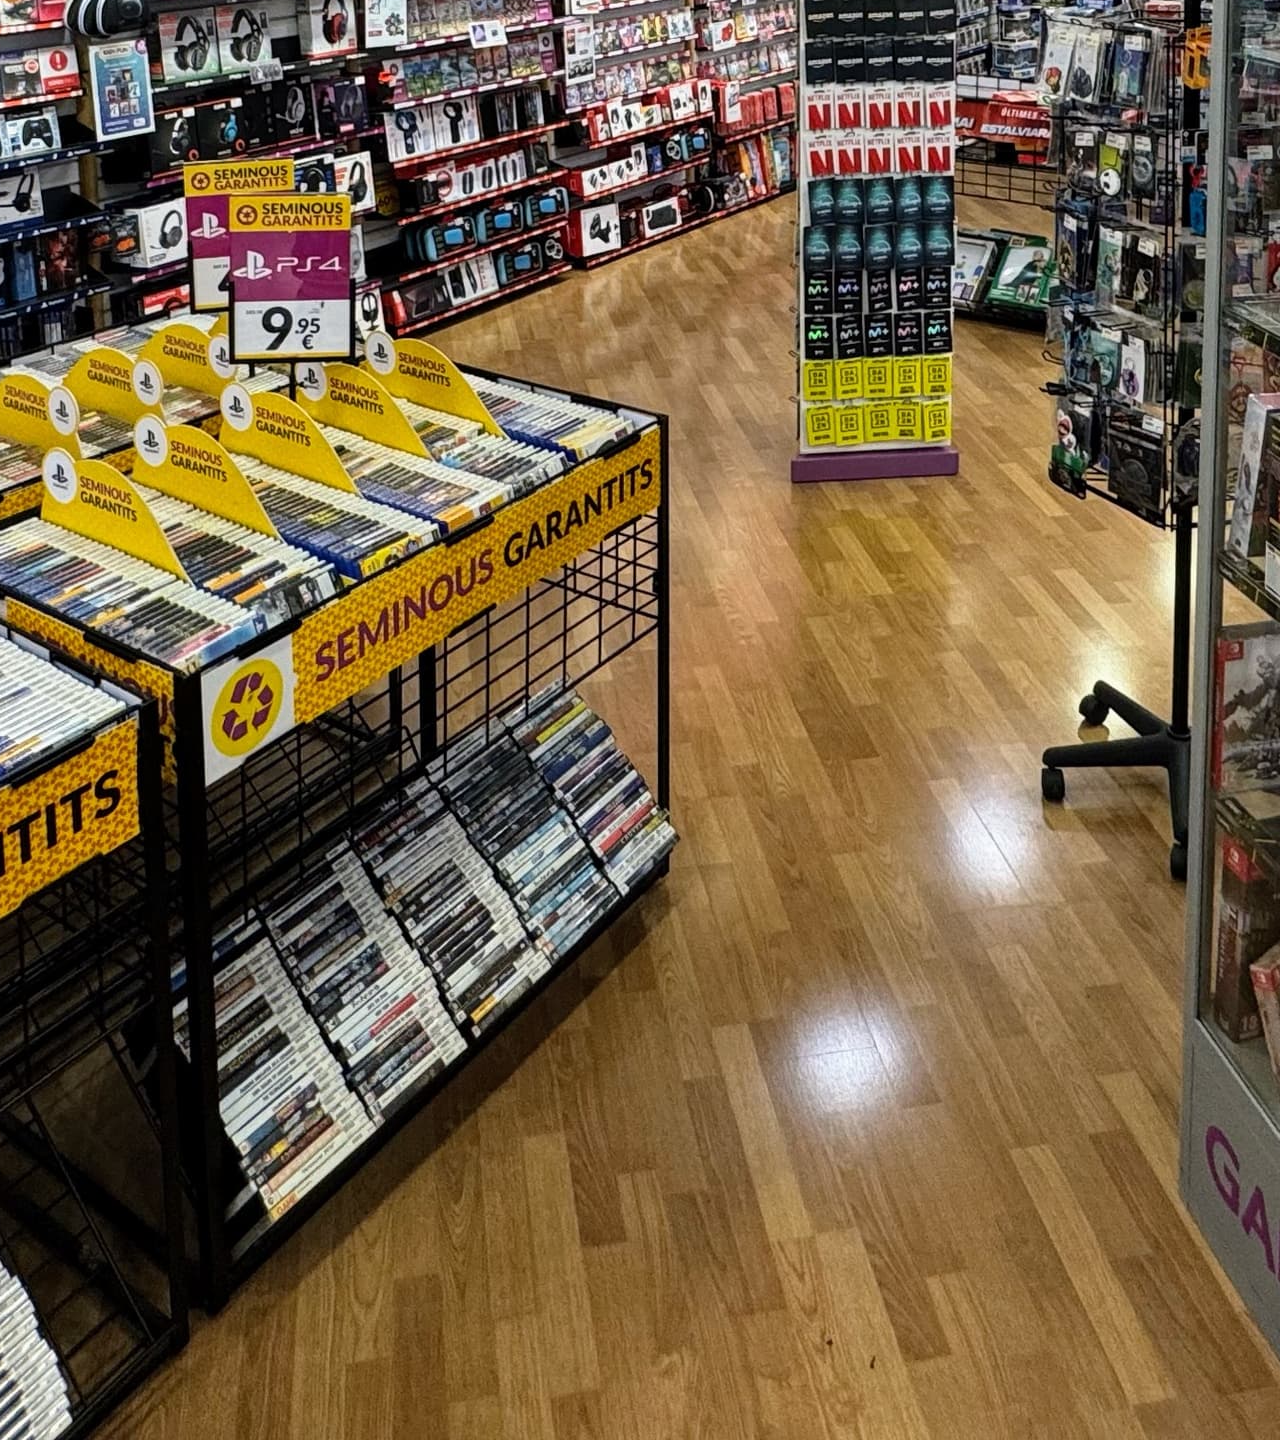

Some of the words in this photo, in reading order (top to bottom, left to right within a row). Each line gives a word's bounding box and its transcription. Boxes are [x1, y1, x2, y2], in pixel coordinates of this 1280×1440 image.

[214, 165, 288, 179] SEMINOUS
[214, 176, 288, 191] GARANTITS
[261, 202, 344, 215] SEMINOUS
[261, 214, 343, 226] GARANTITS
[277, 256, 343, 272] PS4
[162, 344, 207, 366] GARANTITS
[165, 334, 206, 354] SEMINOUS
[89, 358, 130, 380] SEMINOUS
[398, 351, 447, 374] SEMINOUS
[87, 369, 132, 393] GARANTITS
[398, 364, 451, 387] GARANTITS
[5, 385, 46, 408] SEMINOUS
[330, 377, 380, 401] SEMINOUS
[3, 396, 48, 421] GARANTITS
[330, 391, 384, 415] GARANTITS
[256, 407, 306, 432] SEMINOUS
[256, 420, 311, 447] GARANTITS
[171, 440, 223, 466] SEMINOUS
[171, 453, 228, 482] GARANTITS
[80, 476, 132, 506] SEMINOUS
[80, 491, 138, 522] GARANTITS
[314, 549, 495, 682] SEMINOUS
[502, 458, 654, 567] GARANTITS
